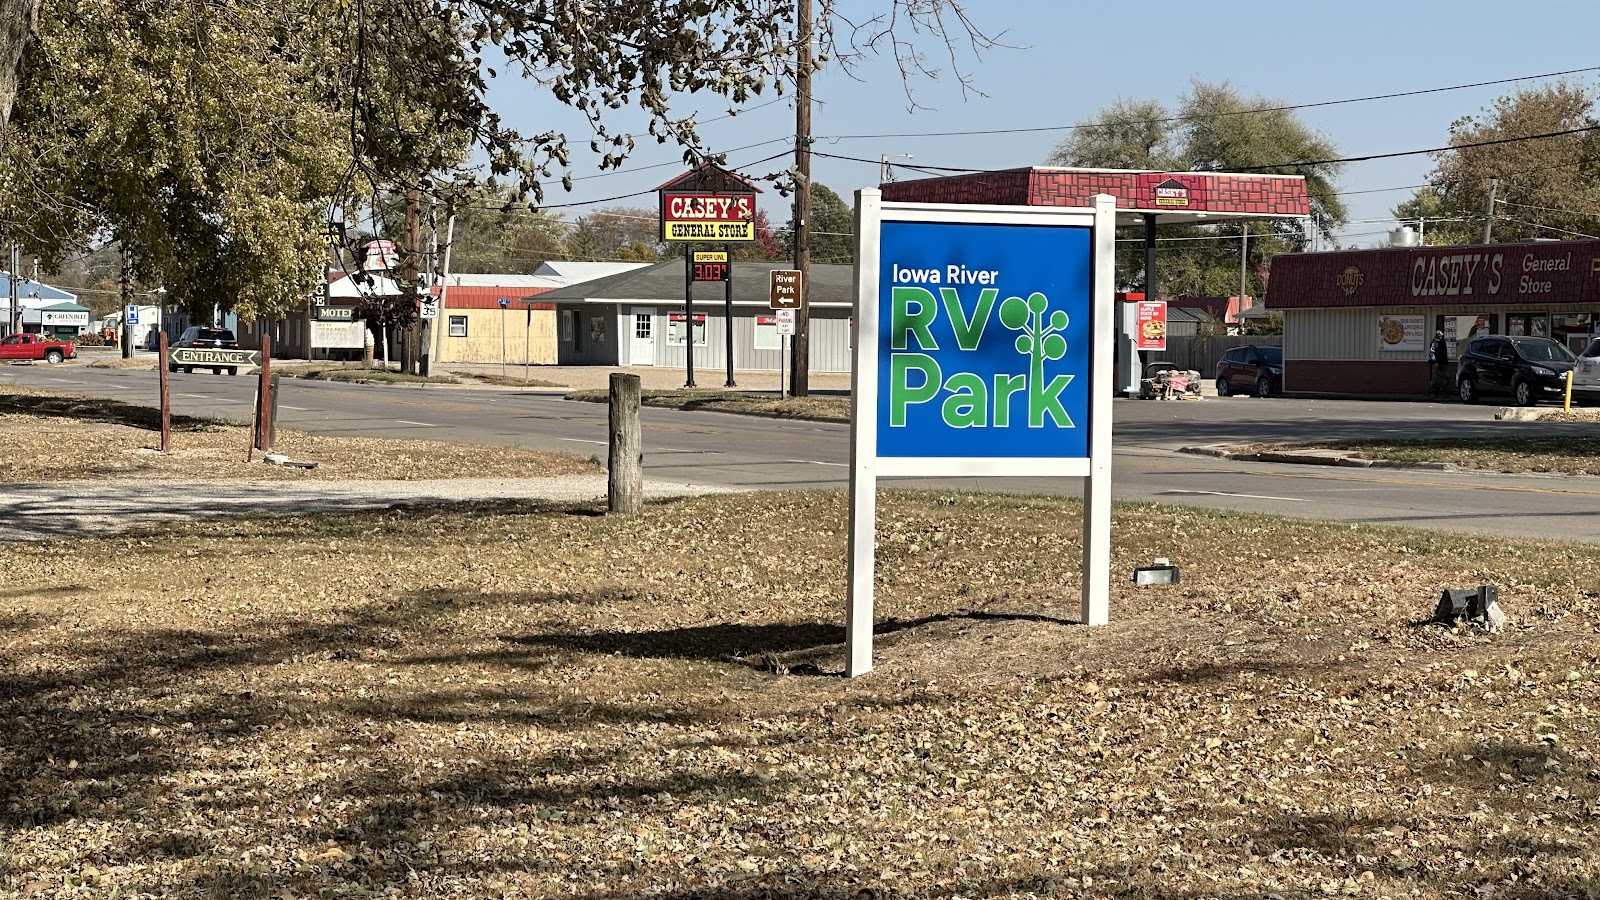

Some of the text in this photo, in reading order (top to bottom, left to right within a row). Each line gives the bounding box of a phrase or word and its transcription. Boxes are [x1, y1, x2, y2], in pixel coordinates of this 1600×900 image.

[1157, 188, 1187, 197] CASEY'S
[671, 197, 748, 219] CASEY'S
[672, 223, 749, 238] GENERAL STORE
[1522, 252, 1571, 271] General
[775, 274, 797, 283] River
[893, 264, 999, 285] Iowa River
[1336, 272, 1364, 286] DONUTS
[1411, 253, 1503, 296] CASEY'S
[776, 285, 795, 294] Park
[1518, 275, 1552, 294] Store
[422, 307, 436, 316] 35
[890, 286, 1000, 351] RV
[182, 350, 245, 363] ENTRANCE
[889, 352, 1076, 428] Park
